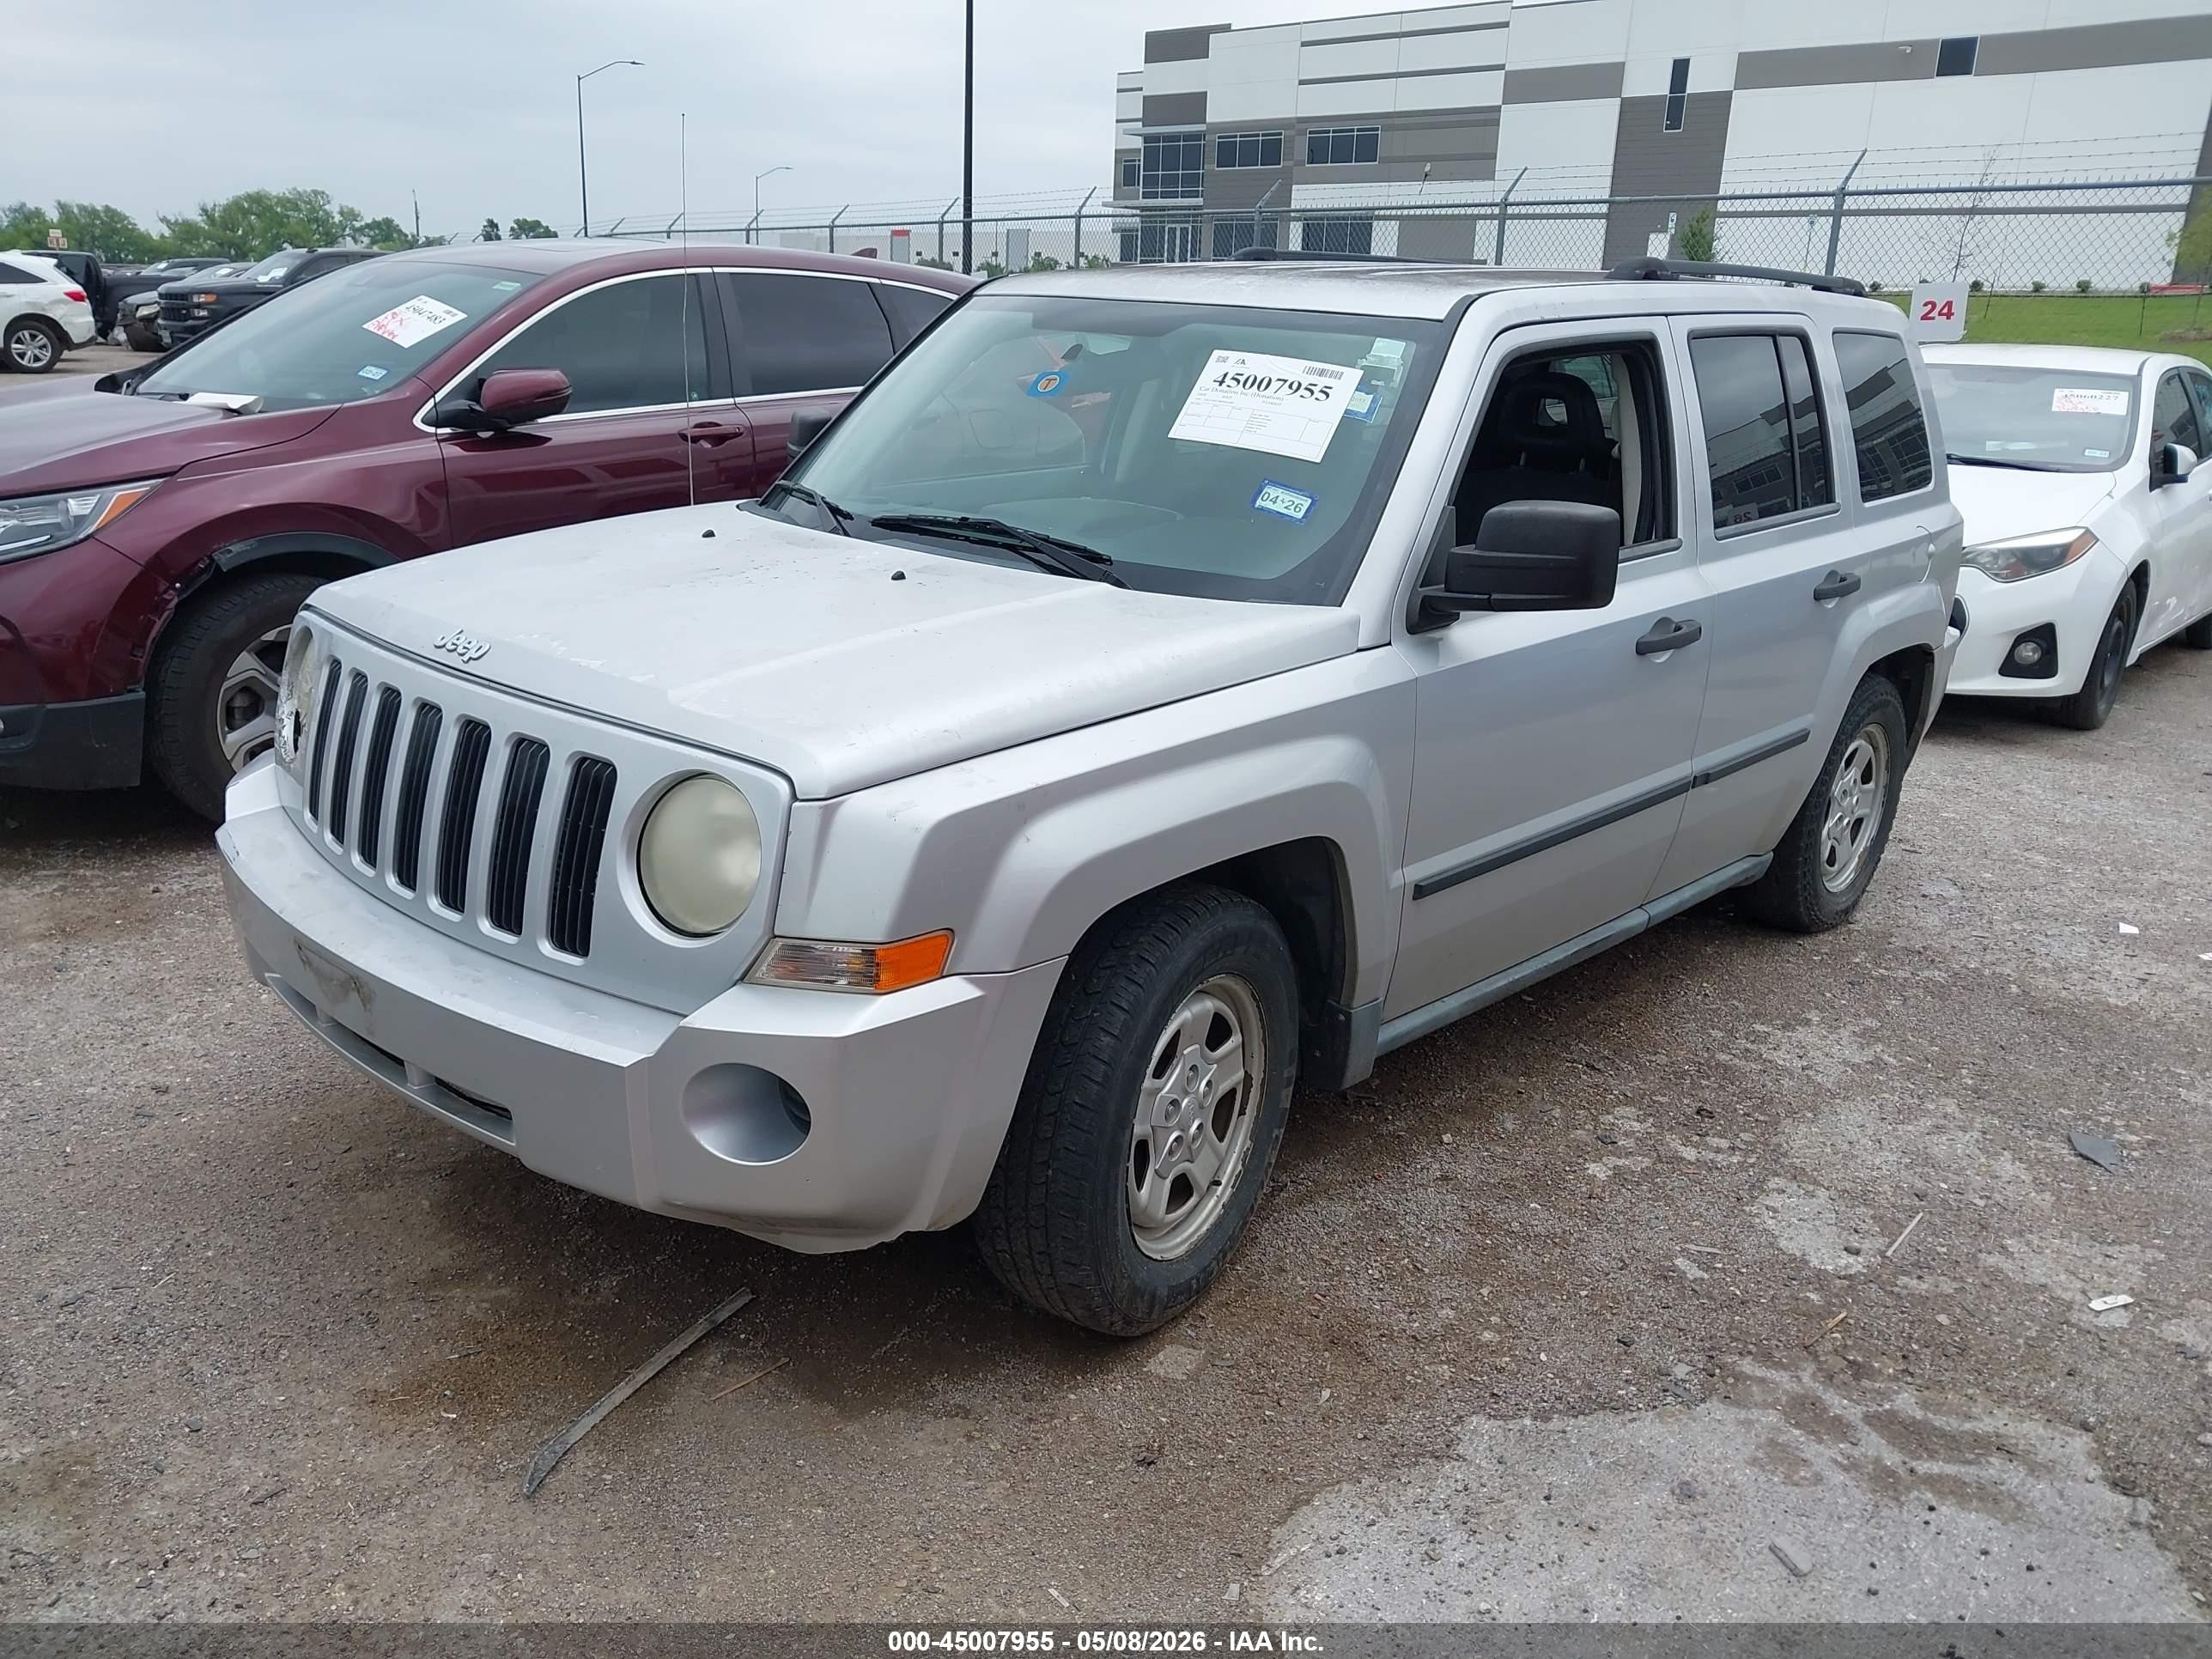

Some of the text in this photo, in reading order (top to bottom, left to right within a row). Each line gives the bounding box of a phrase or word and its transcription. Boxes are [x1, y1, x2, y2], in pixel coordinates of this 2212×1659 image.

[1920, 301, 1955, 320] 24
[1212, 371, 1334, 403] 45007955
[433, 628, 492, 664] Jeep
